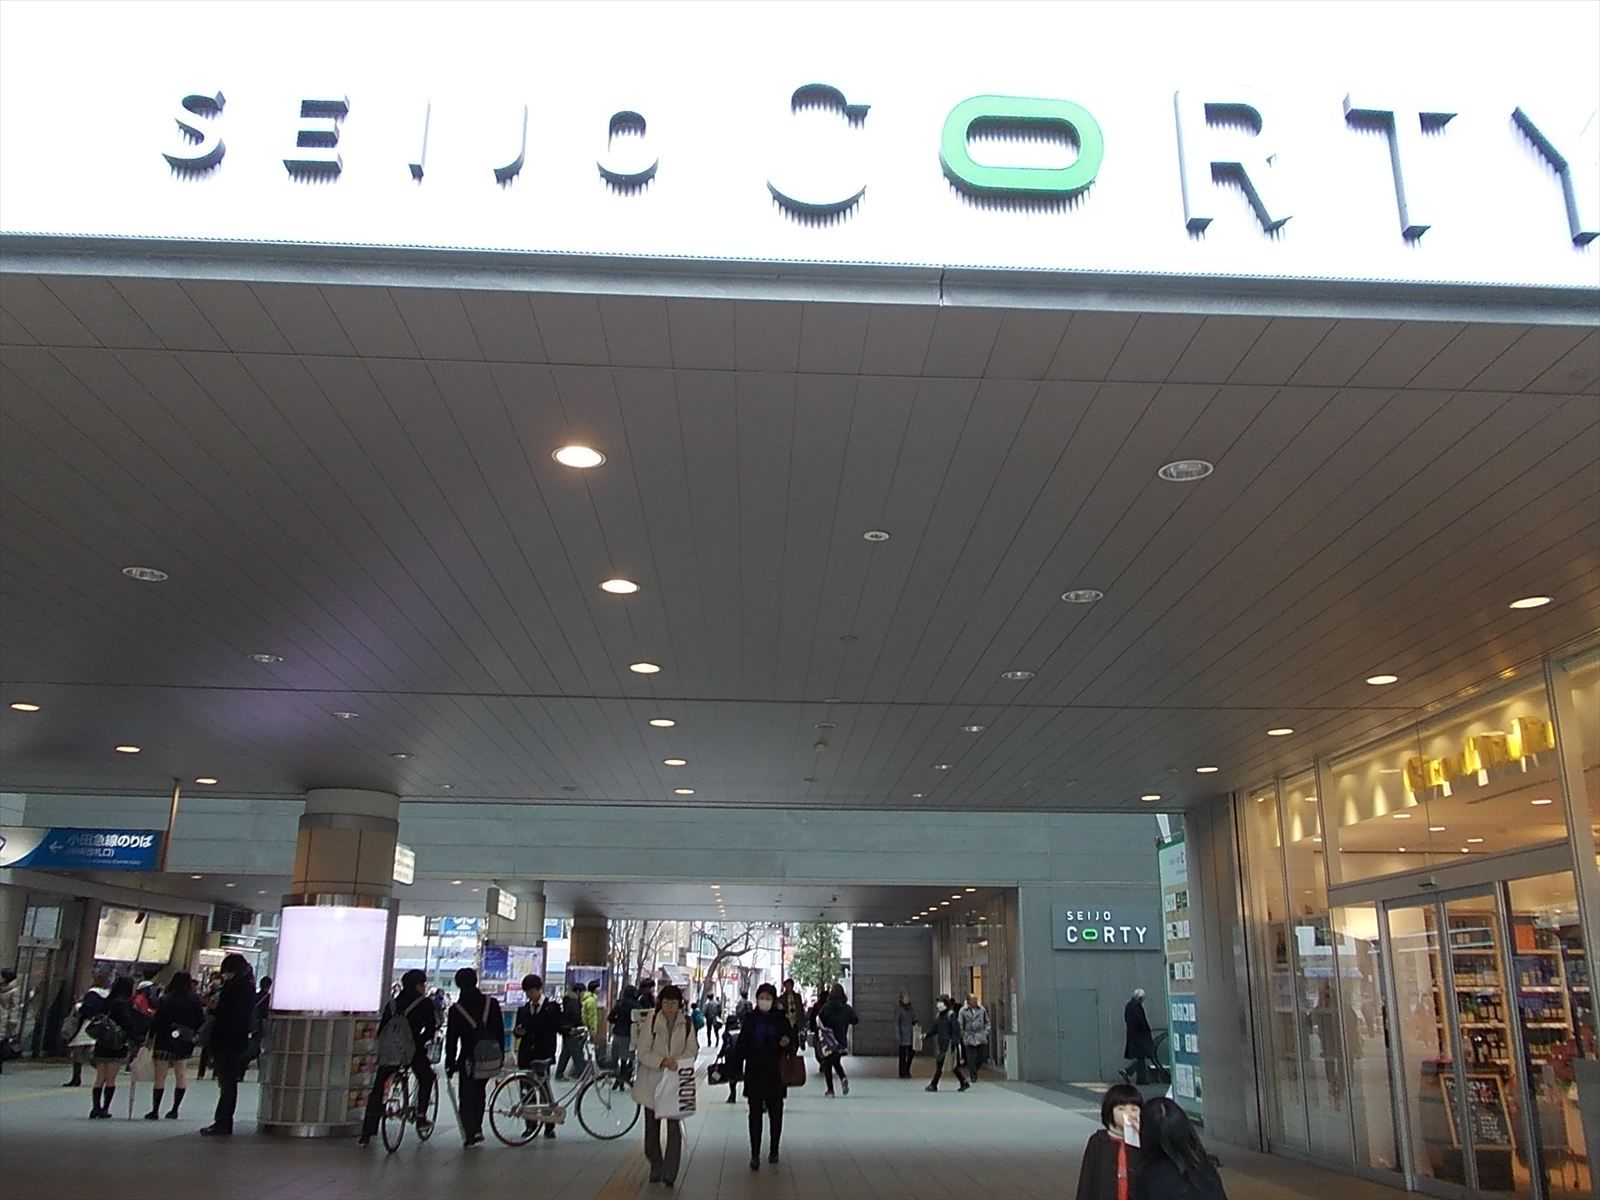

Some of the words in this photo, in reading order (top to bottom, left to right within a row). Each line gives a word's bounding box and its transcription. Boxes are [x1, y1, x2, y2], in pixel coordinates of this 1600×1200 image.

[161, 82, 660, 197] SEIJO
[766, 73, 1600, 247] CORTY
[67, 834, 154, 848] 小田急線のりば
[1066, 910, 1112, 921] SEIJO
[1066, 926, 1147, 943] CORTY
